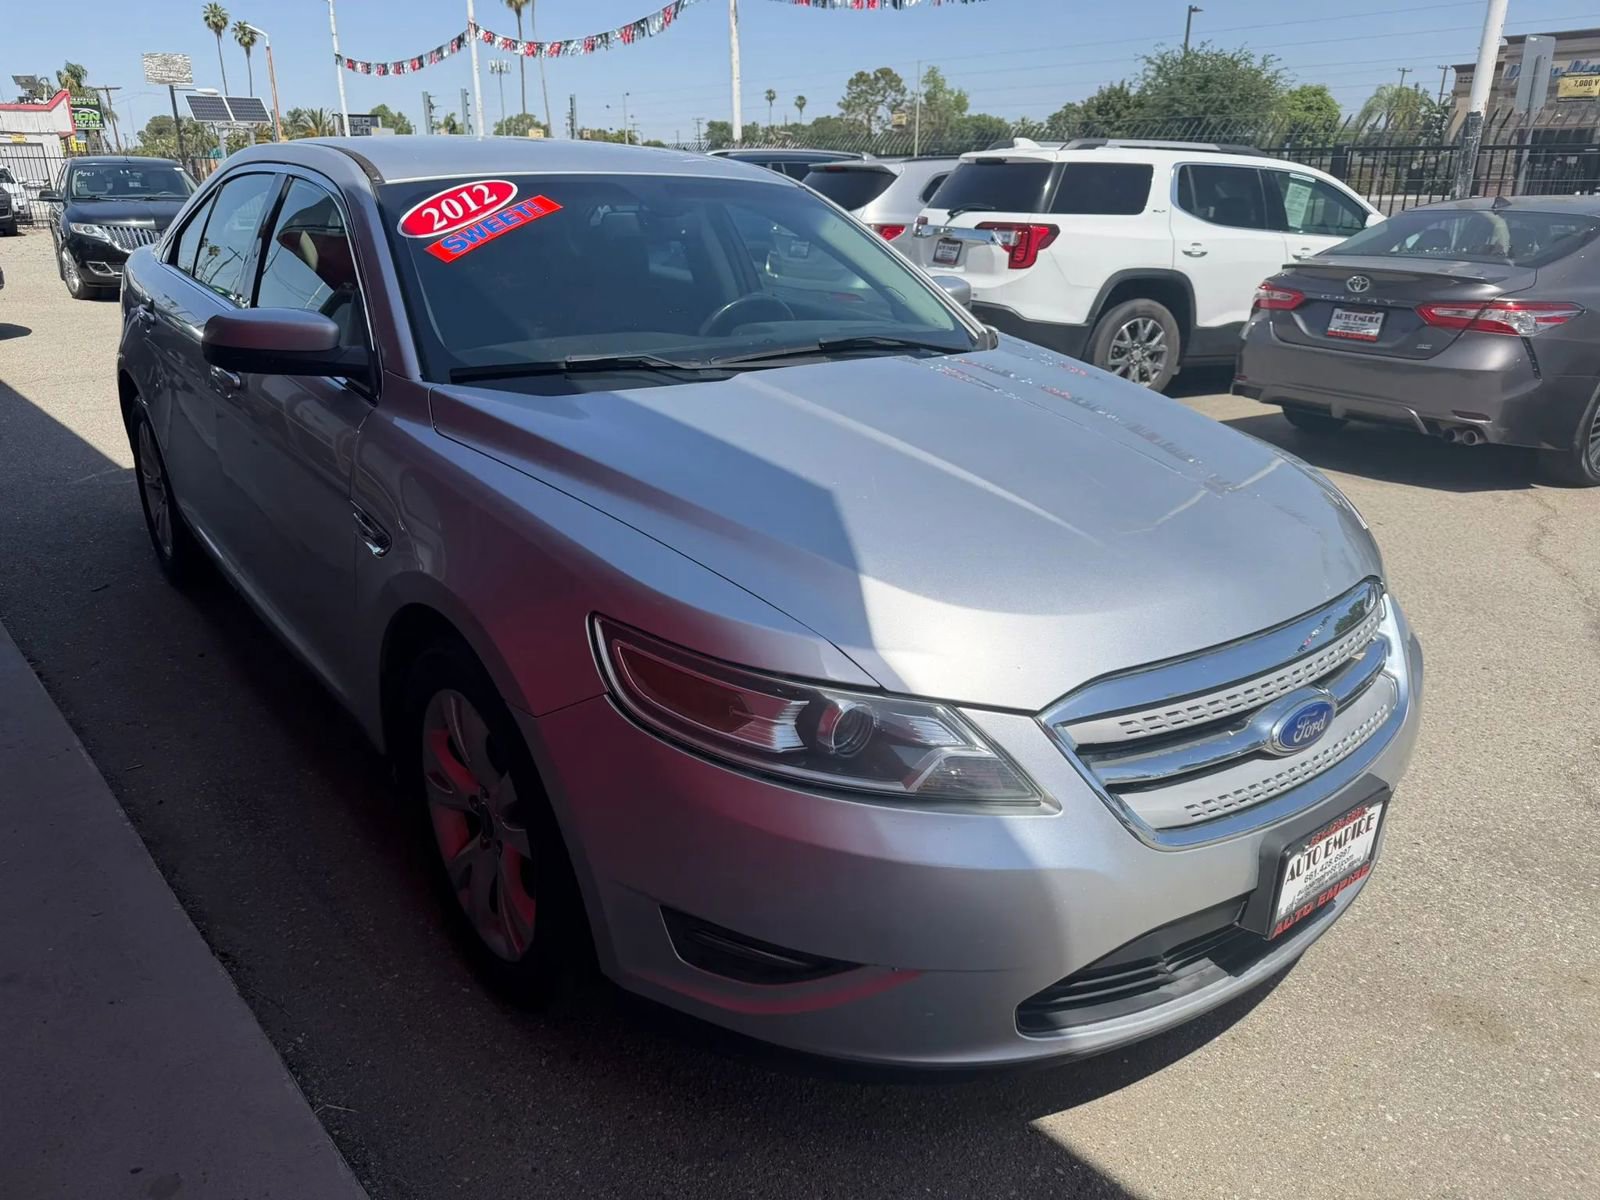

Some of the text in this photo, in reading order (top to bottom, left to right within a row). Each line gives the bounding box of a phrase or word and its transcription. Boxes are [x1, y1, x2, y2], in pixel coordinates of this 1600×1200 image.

[421, 184, 498, 231] 2012
[440, 201, 544, 253] SWEET!
[1293, 710, 1327, 743] Ford
[1285, 845, 1322, 885] AUTO
[1324, 812, 1375, 859] EMPIRE
[1273, 901, 1314, 938] AUTO
[1318, 861, 1370, 907] EMPIRE
